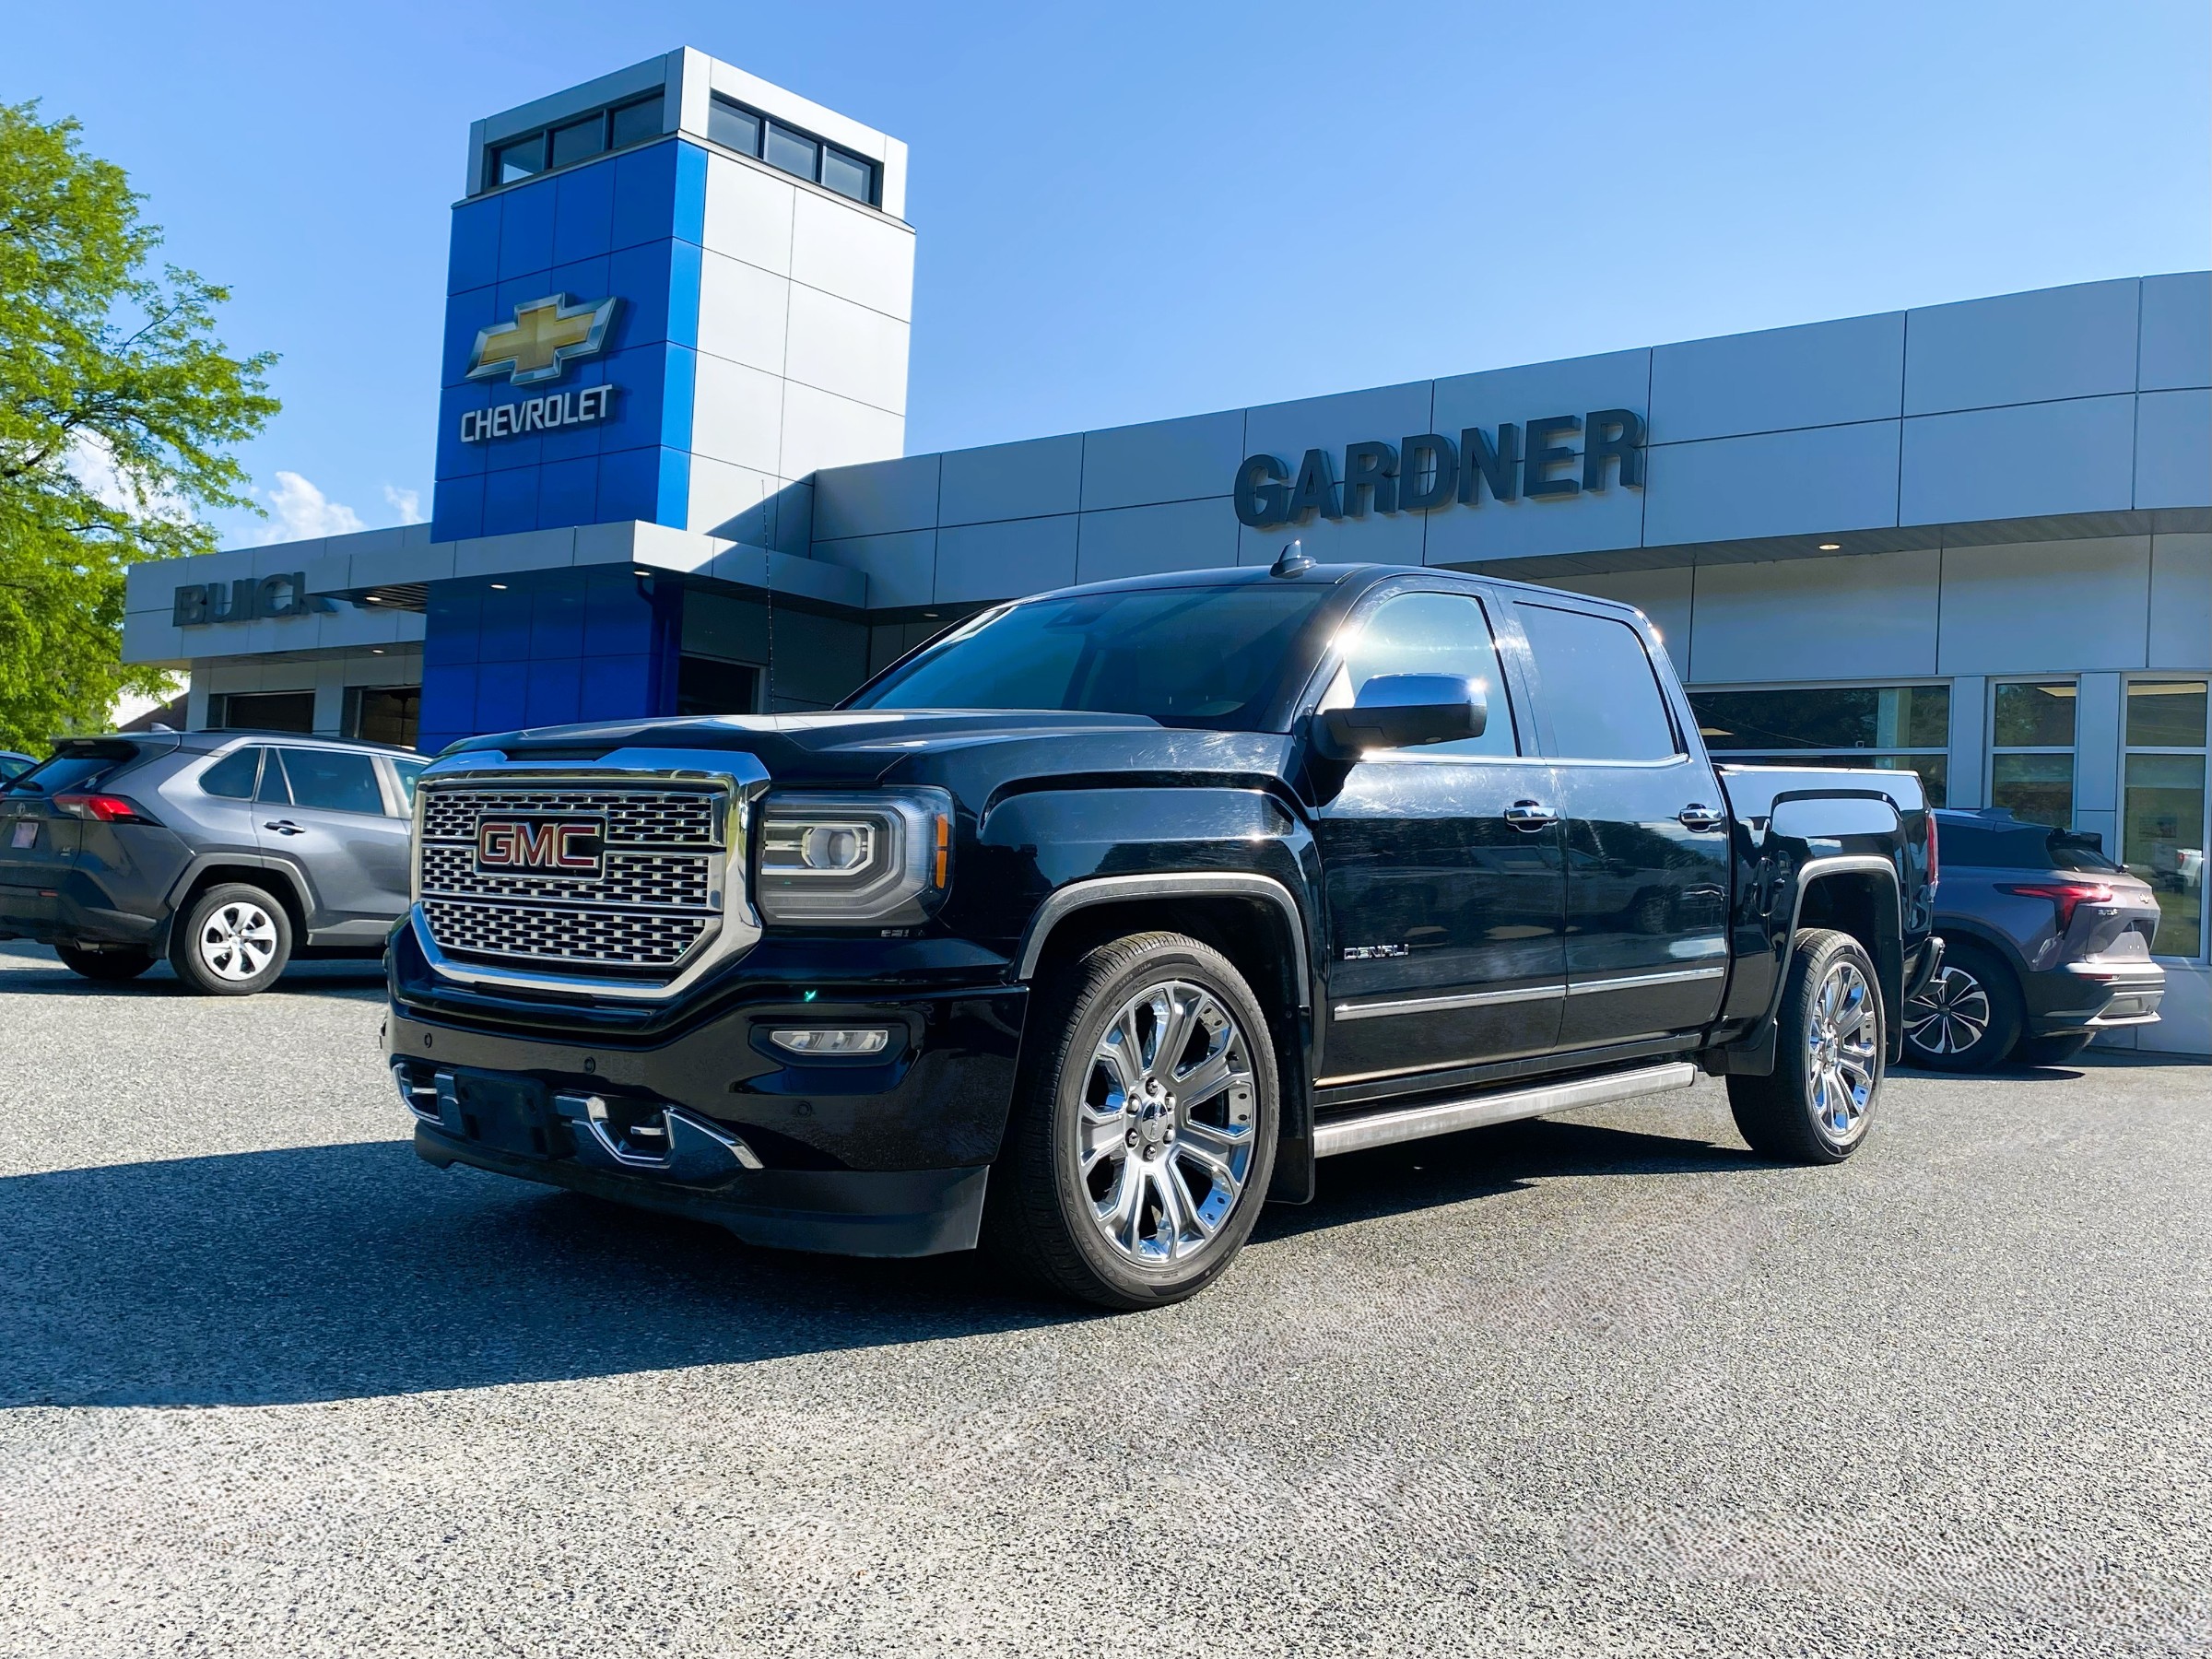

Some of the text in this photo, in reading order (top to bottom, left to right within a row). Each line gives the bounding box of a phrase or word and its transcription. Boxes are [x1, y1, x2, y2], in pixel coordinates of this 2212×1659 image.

[460, 383, 613, 443] CHEVROLET
[1233, 408, 1645, 528] GARDNER
[479, 822, 600, 869] GMC
[1344, 944, 1409, 959] DENALI
